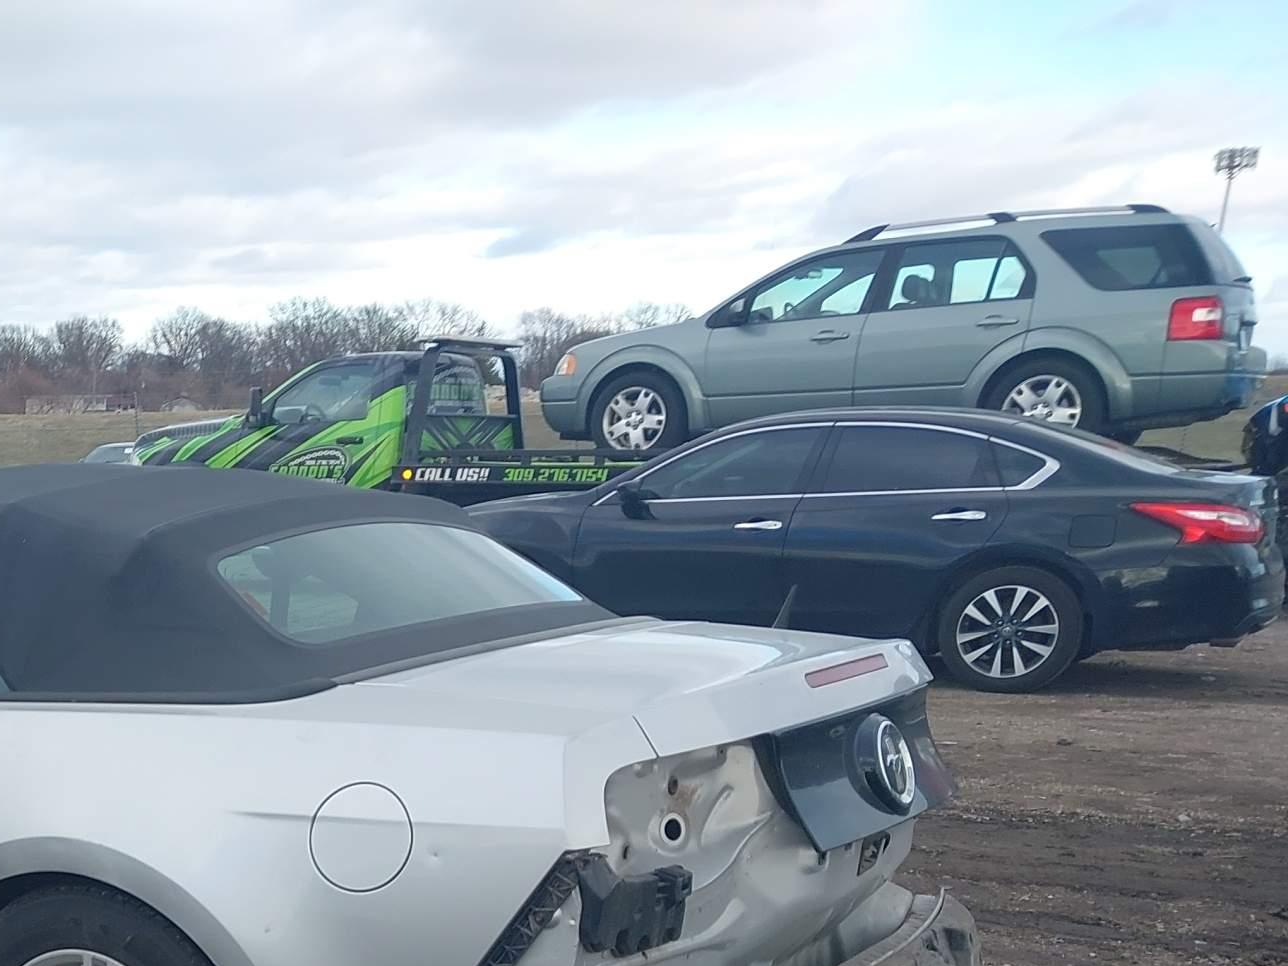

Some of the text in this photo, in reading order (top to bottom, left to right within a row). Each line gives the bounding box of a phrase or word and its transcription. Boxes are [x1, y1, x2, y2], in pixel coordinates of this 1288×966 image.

[415, 467, 608, 482] CALL US!! 309.276.7154
